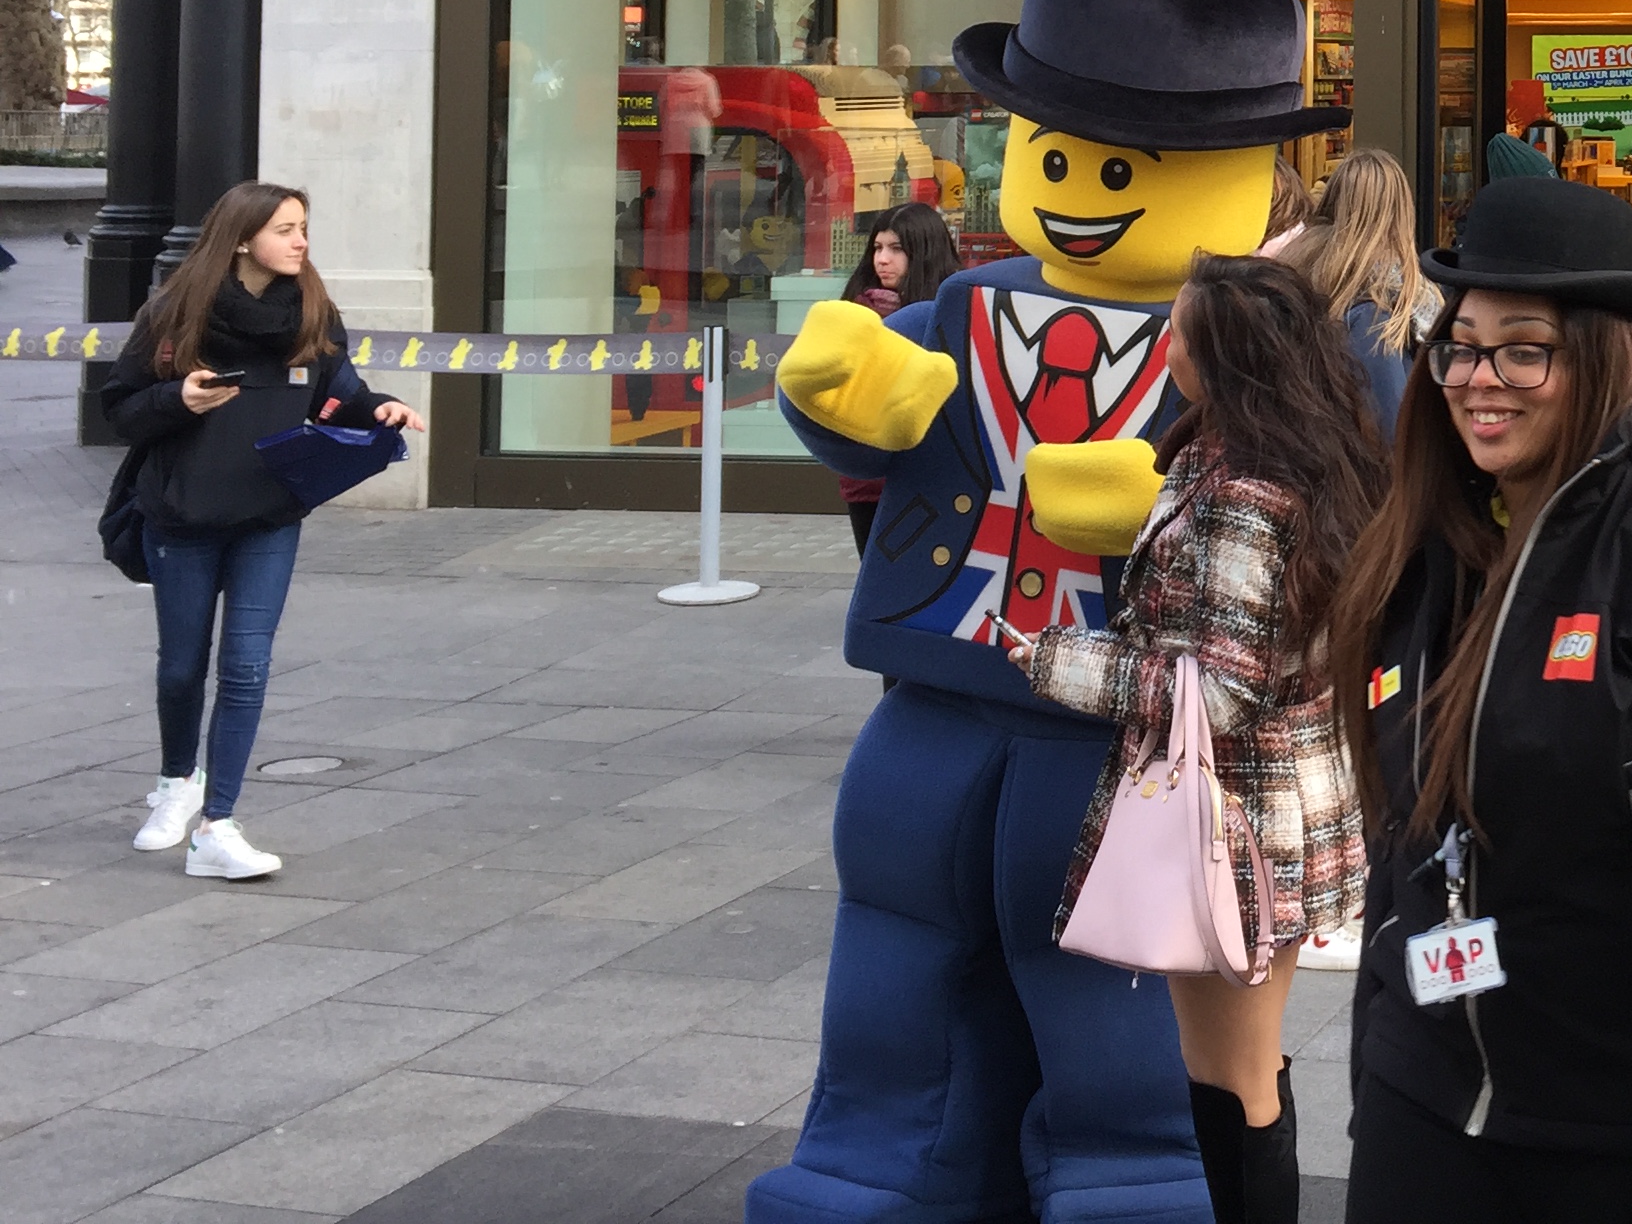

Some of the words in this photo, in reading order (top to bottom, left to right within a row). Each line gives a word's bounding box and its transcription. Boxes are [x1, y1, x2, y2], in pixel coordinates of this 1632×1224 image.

[1551, 48, 1601, 70] SAVE
[1536, 74, 1550, 82] ON
[1551, 72, 1572, 82] OUR
[1573, 69, 1609, 81] EASTER
[1562, 80, 1589, 88] MARCH
